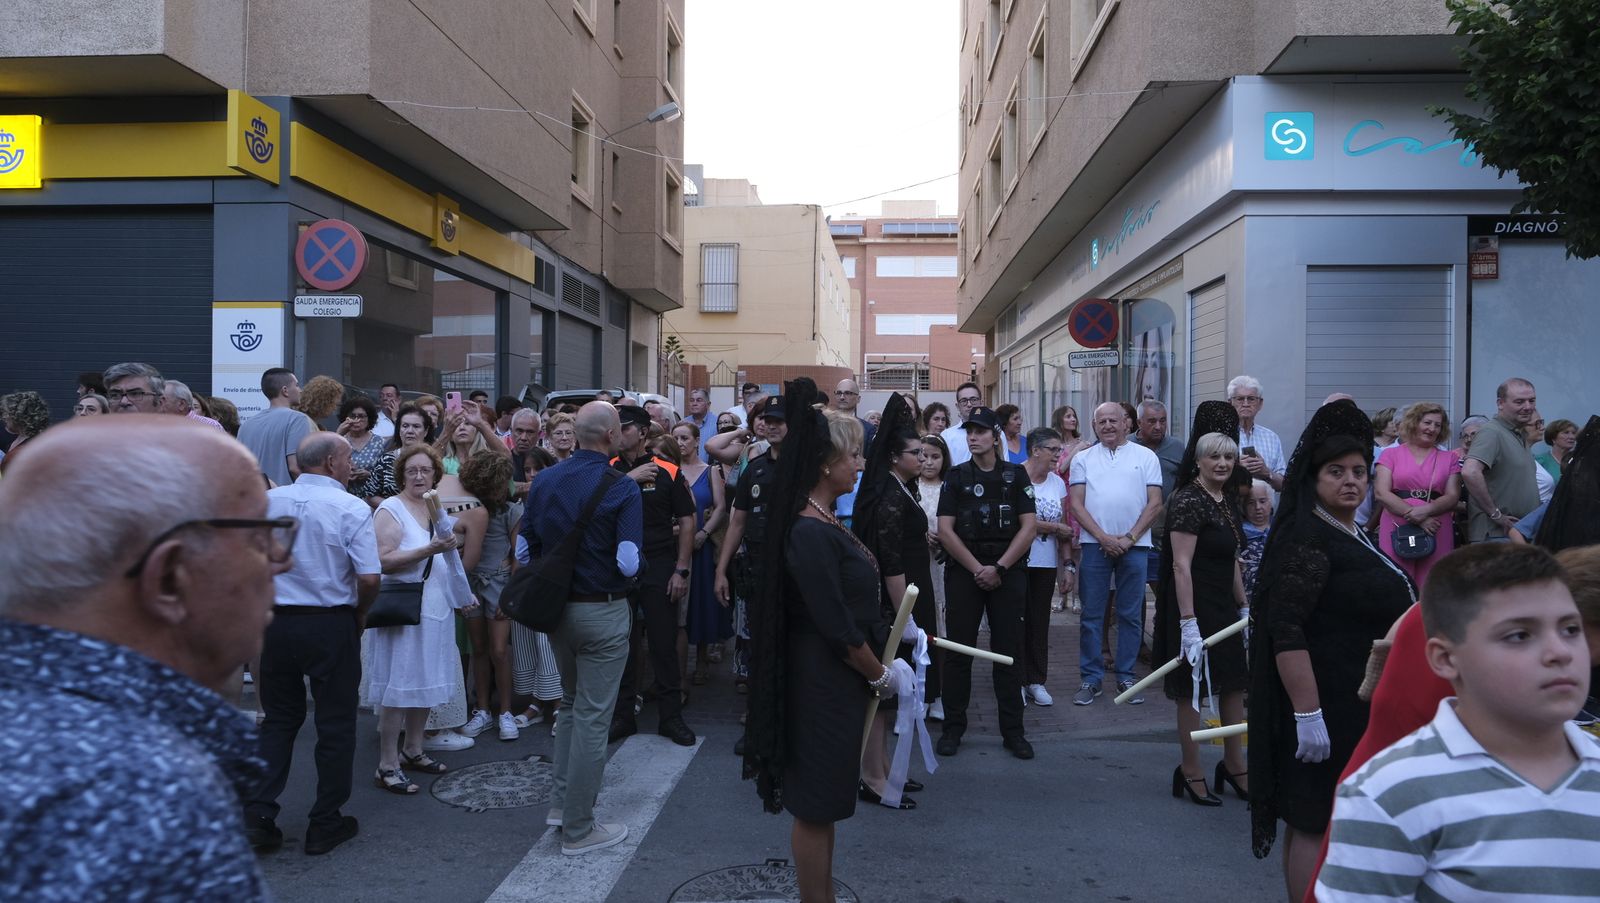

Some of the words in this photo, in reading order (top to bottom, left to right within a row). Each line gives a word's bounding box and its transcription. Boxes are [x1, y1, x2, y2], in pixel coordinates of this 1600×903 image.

[1494, 219, 1566, 233] DIAGNÓ
[296, 297, 318, 305] SALIDA
[319, 297, 359, 305] EMERGENCIA
[313, 307, 342, 315] COLEGIO
